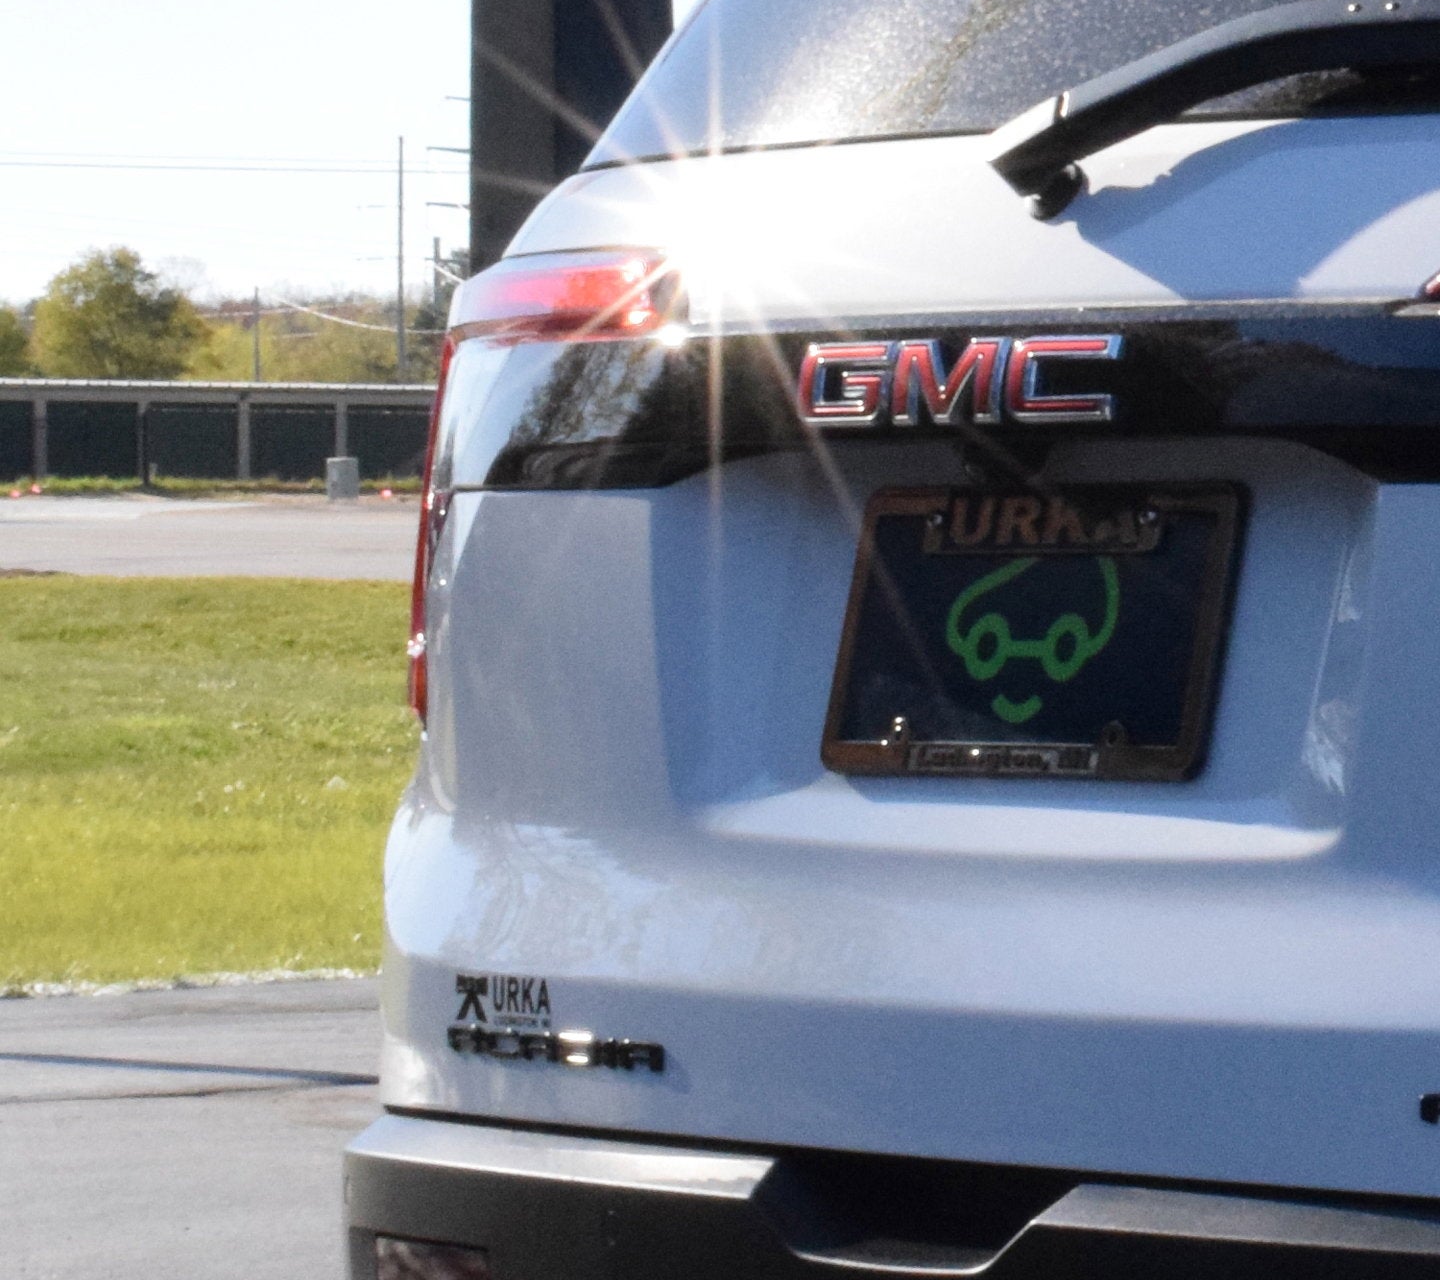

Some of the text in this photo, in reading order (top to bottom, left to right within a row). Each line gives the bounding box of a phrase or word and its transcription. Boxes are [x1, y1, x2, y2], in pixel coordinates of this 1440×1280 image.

[800, 334, 1123, 425] GMC
[492, 976, 551, 1014] URKA
[447, 1024, 664, 1072] ACADIA
